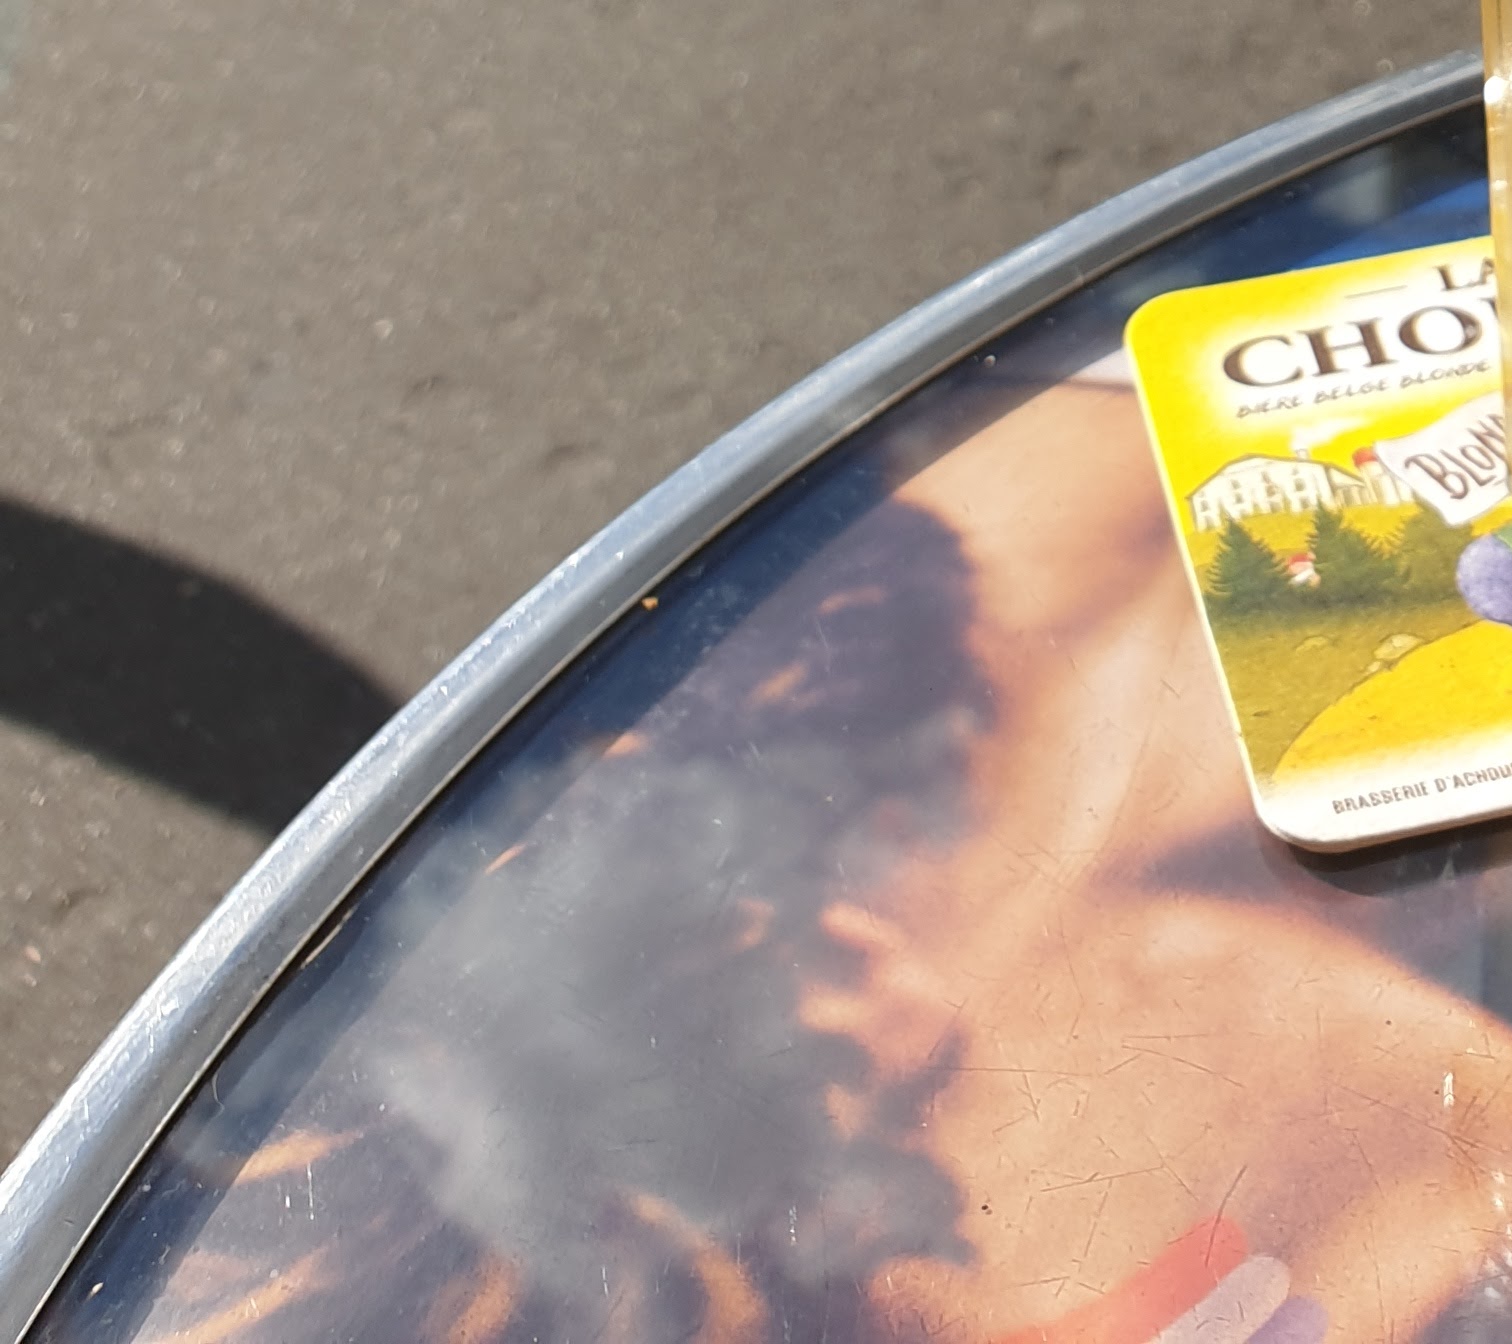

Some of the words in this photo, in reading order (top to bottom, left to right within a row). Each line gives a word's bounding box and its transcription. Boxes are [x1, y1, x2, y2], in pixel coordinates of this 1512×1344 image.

[1222, 296, 1499, 388] CHO
[1314, 378, 1388, 404] BELGE
[1399, 360, 1491, 388] BLONDE
[1404, 413, 1506, 500] BLON
[1332, 782, 1428, 814] BRASSERIE
